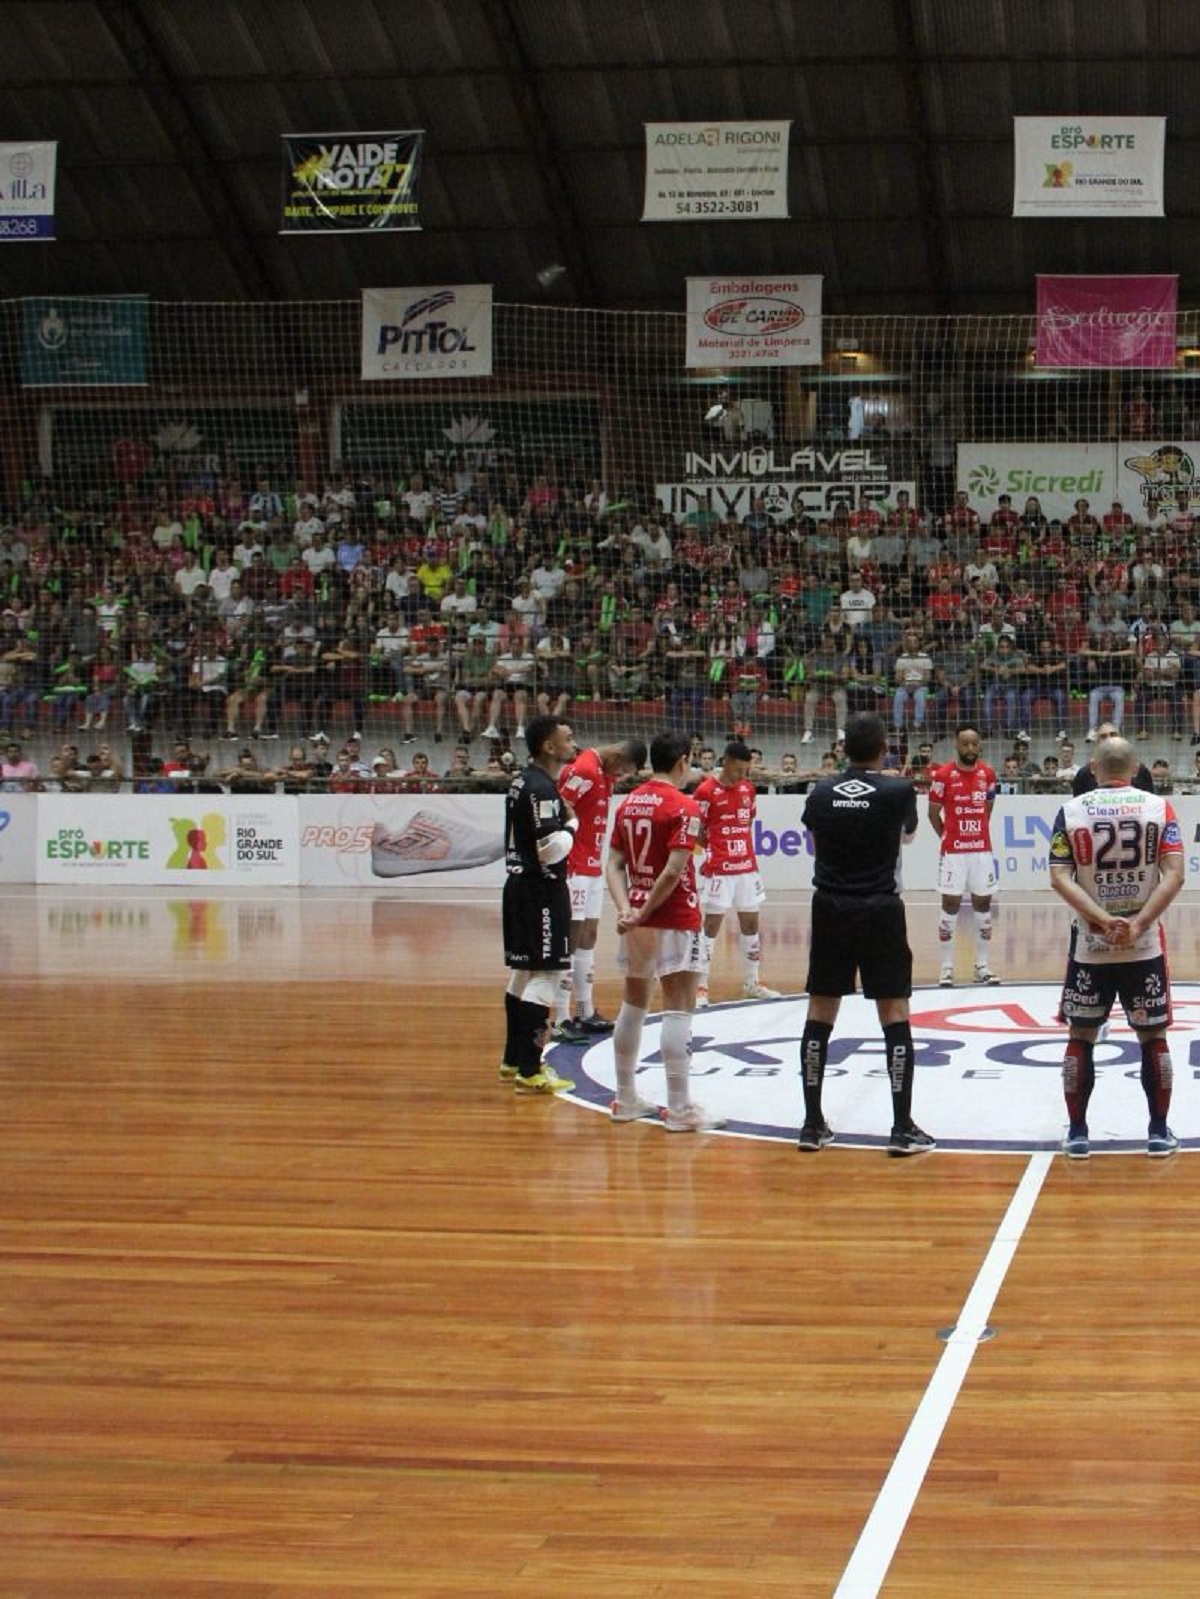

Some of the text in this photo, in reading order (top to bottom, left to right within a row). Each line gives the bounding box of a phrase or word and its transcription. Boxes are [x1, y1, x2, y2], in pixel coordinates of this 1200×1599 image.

[725, 131, 781, 145] RIGONI
[1051, 134, 1135, 150] ESPORTE
[709, 281, 799, 295] Embalagens
[698, 337, 745, 349] Material
[746, 337, 761, 348] de
[1006, 469, 1105, 494] Sicredi
[832, 797, 870, 809] umbro
[959, 819, 982, 832] URI
[58, 828, 84, 840] pró
[237, 828, 256, 838] RIO
[47, 839, 149, 859] ESPORTE
[237, 839, 283, 849] GRANDE
[623, 818, 654, 874] 12
[1093, 820, 1142, 870] 23
[237, 851, 277, 860] DO SUL
[1094, 871, 1147, 884] GESSE
[542, 907, 551, 959] TRAÇADO
[806, 1040, 820, 1087] umbro
[892, 1045, 906, 1094] umbro
